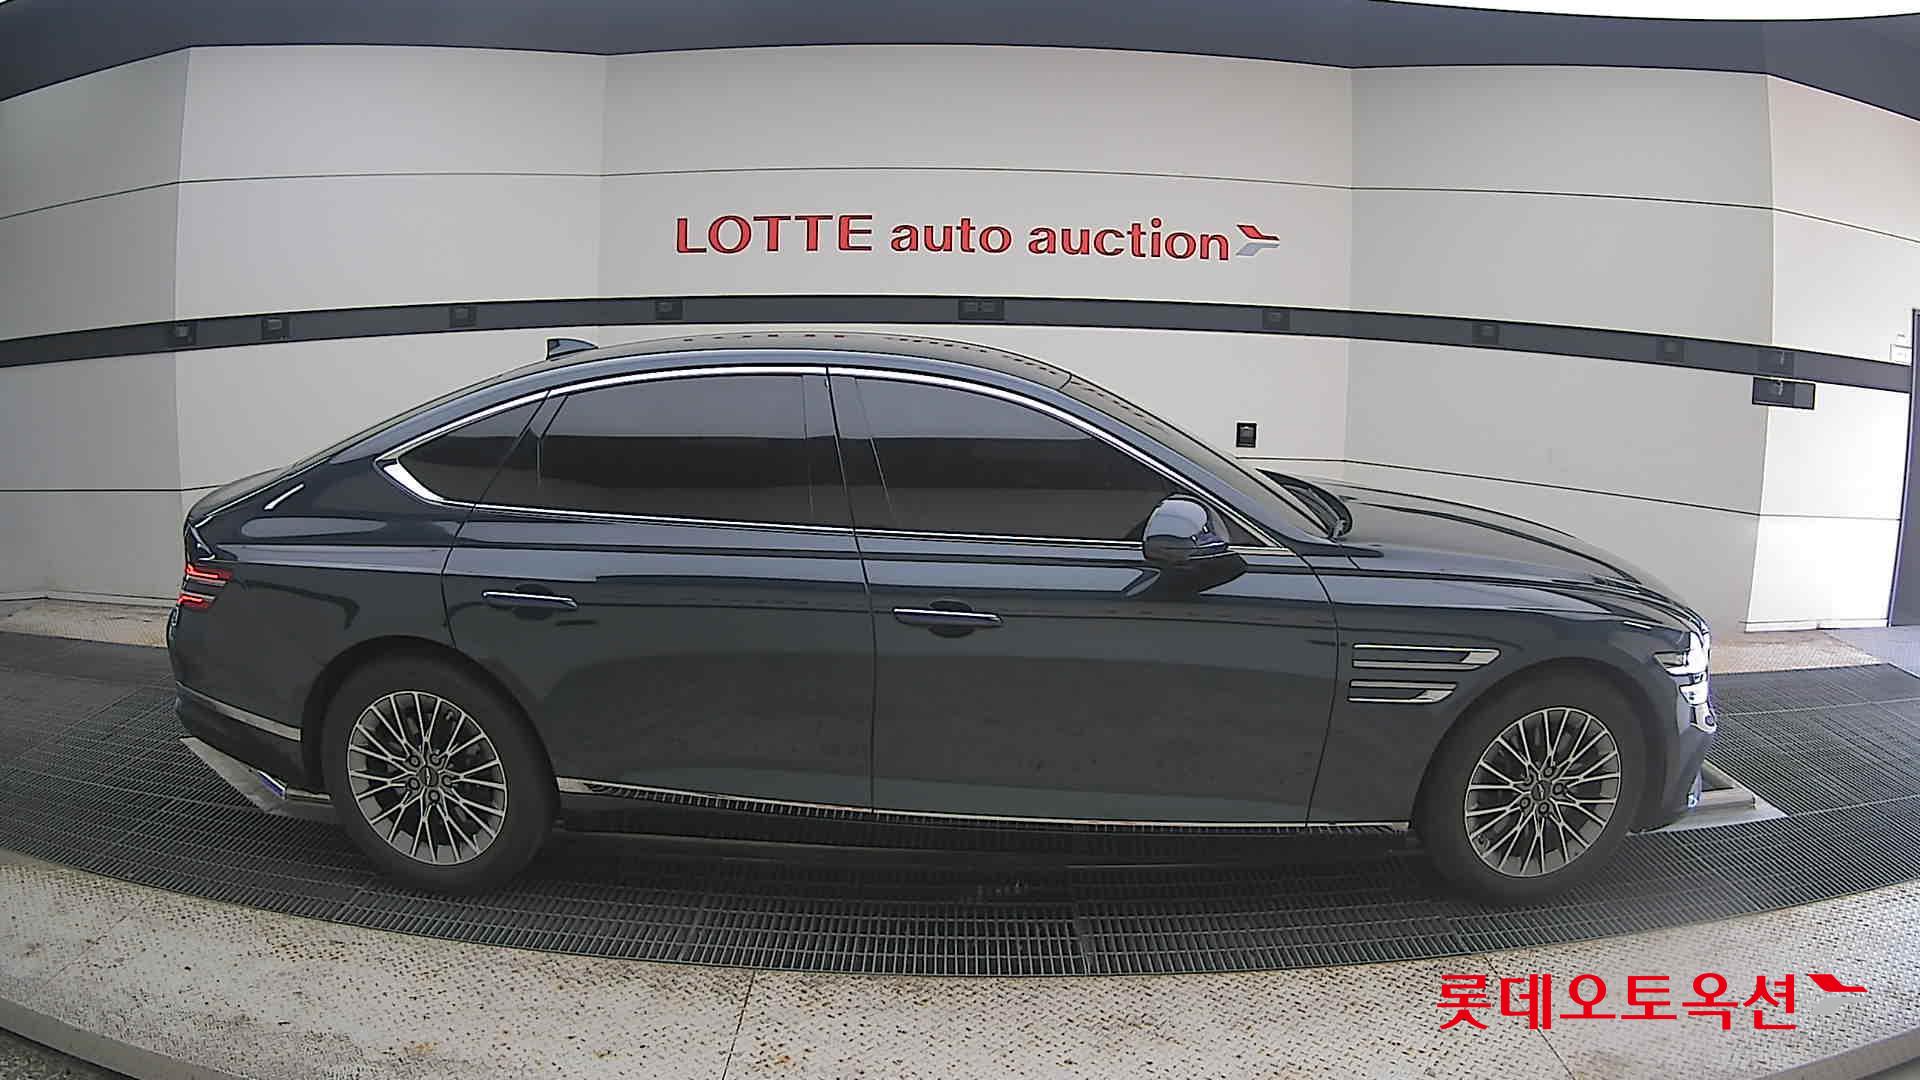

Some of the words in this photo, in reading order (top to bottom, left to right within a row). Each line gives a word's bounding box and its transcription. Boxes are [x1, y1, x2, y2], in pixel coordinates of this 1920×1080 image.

[676, 214, 873, 254] LOTTE
[890, 217, 1012, 255] auto
[1027, 217, 1230, 261] auction
